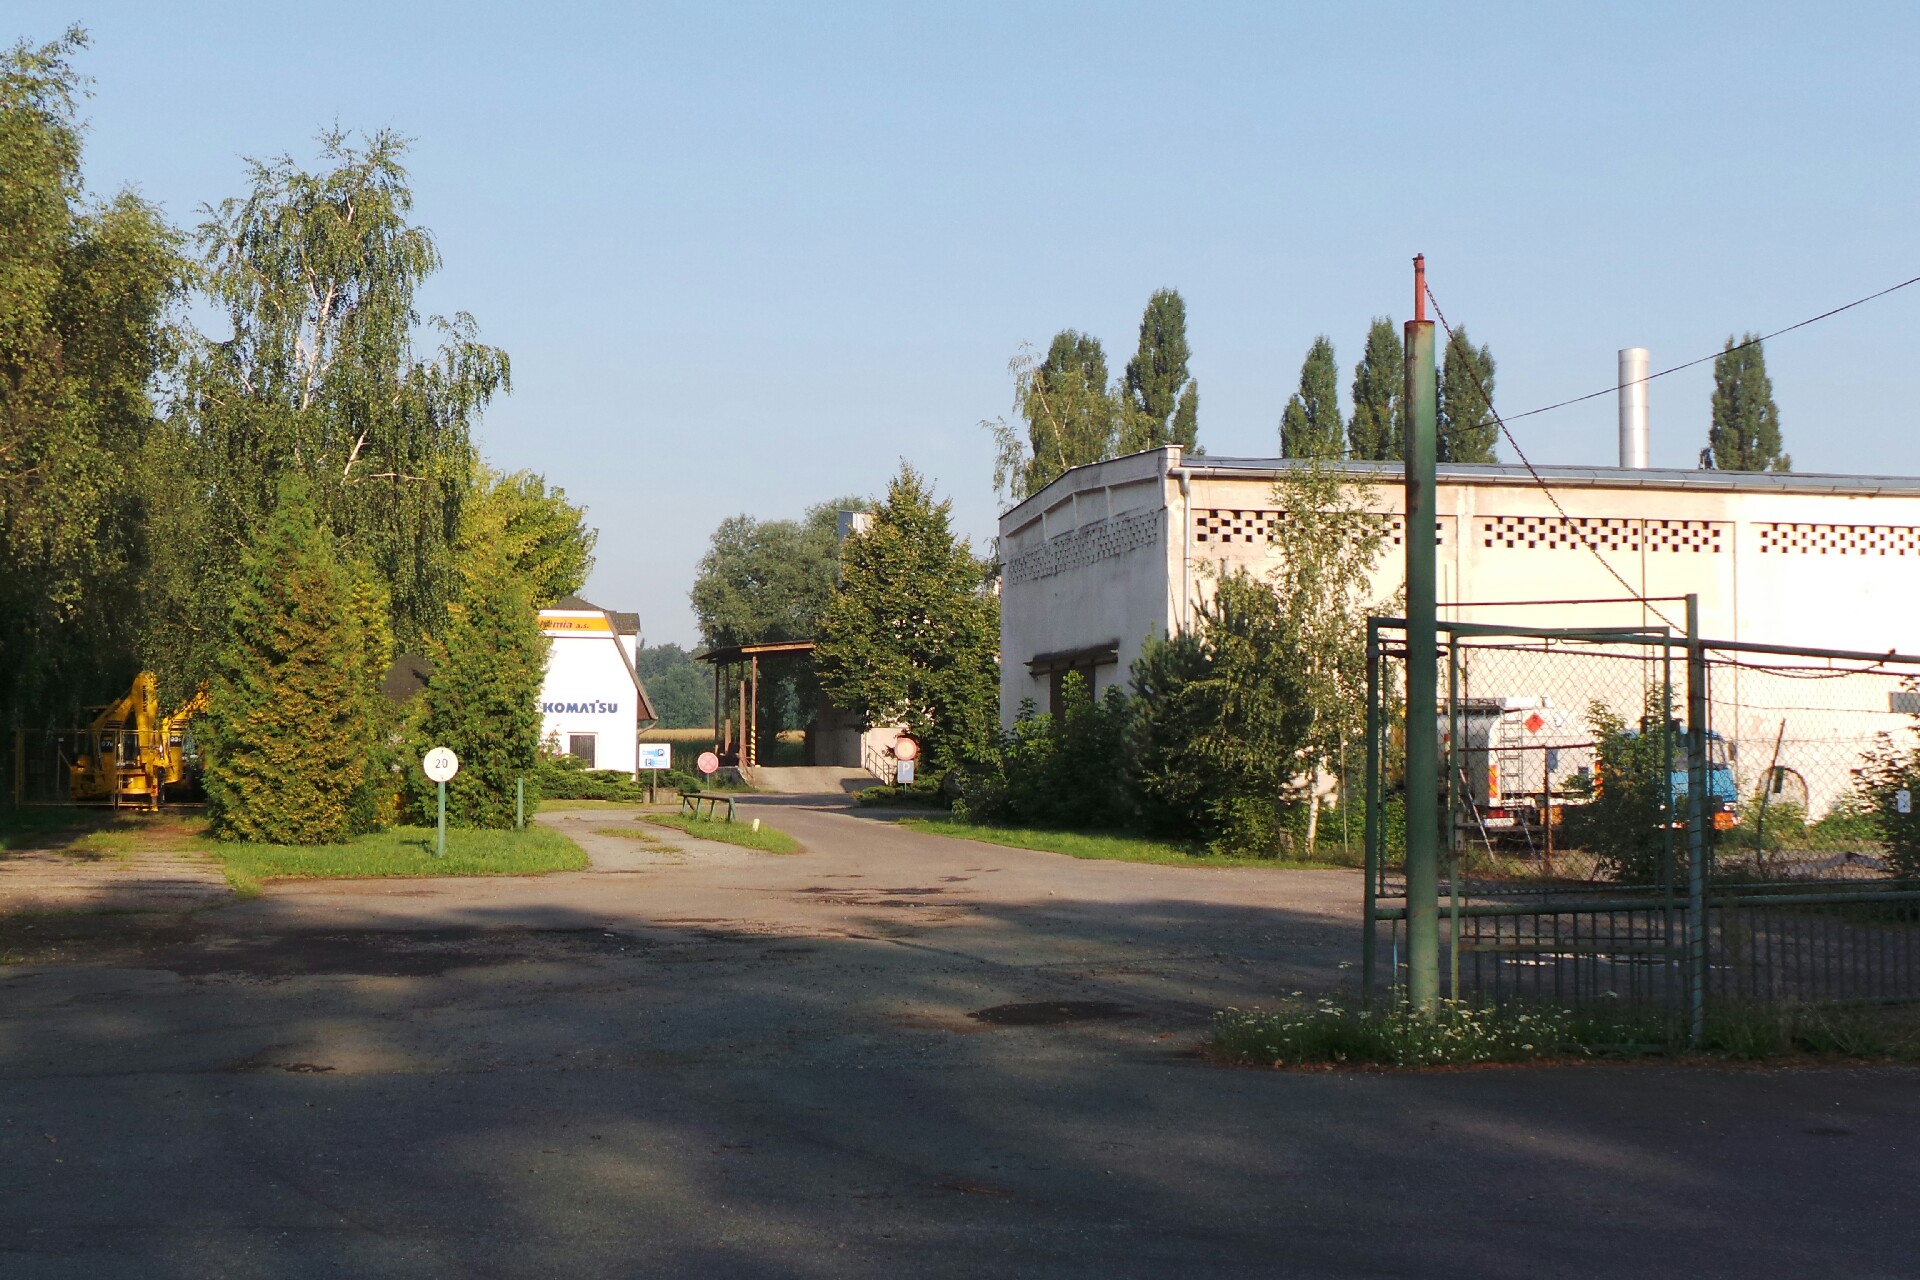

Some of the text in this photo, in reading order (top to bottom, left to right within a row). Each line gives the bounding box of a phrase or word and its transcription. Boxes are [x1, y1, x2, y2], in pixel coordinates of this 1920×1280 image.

[542, 700, 618, 713] KOMATSU
[435, 758, 448, 768] 20
[903, 762, 910, 775] P
